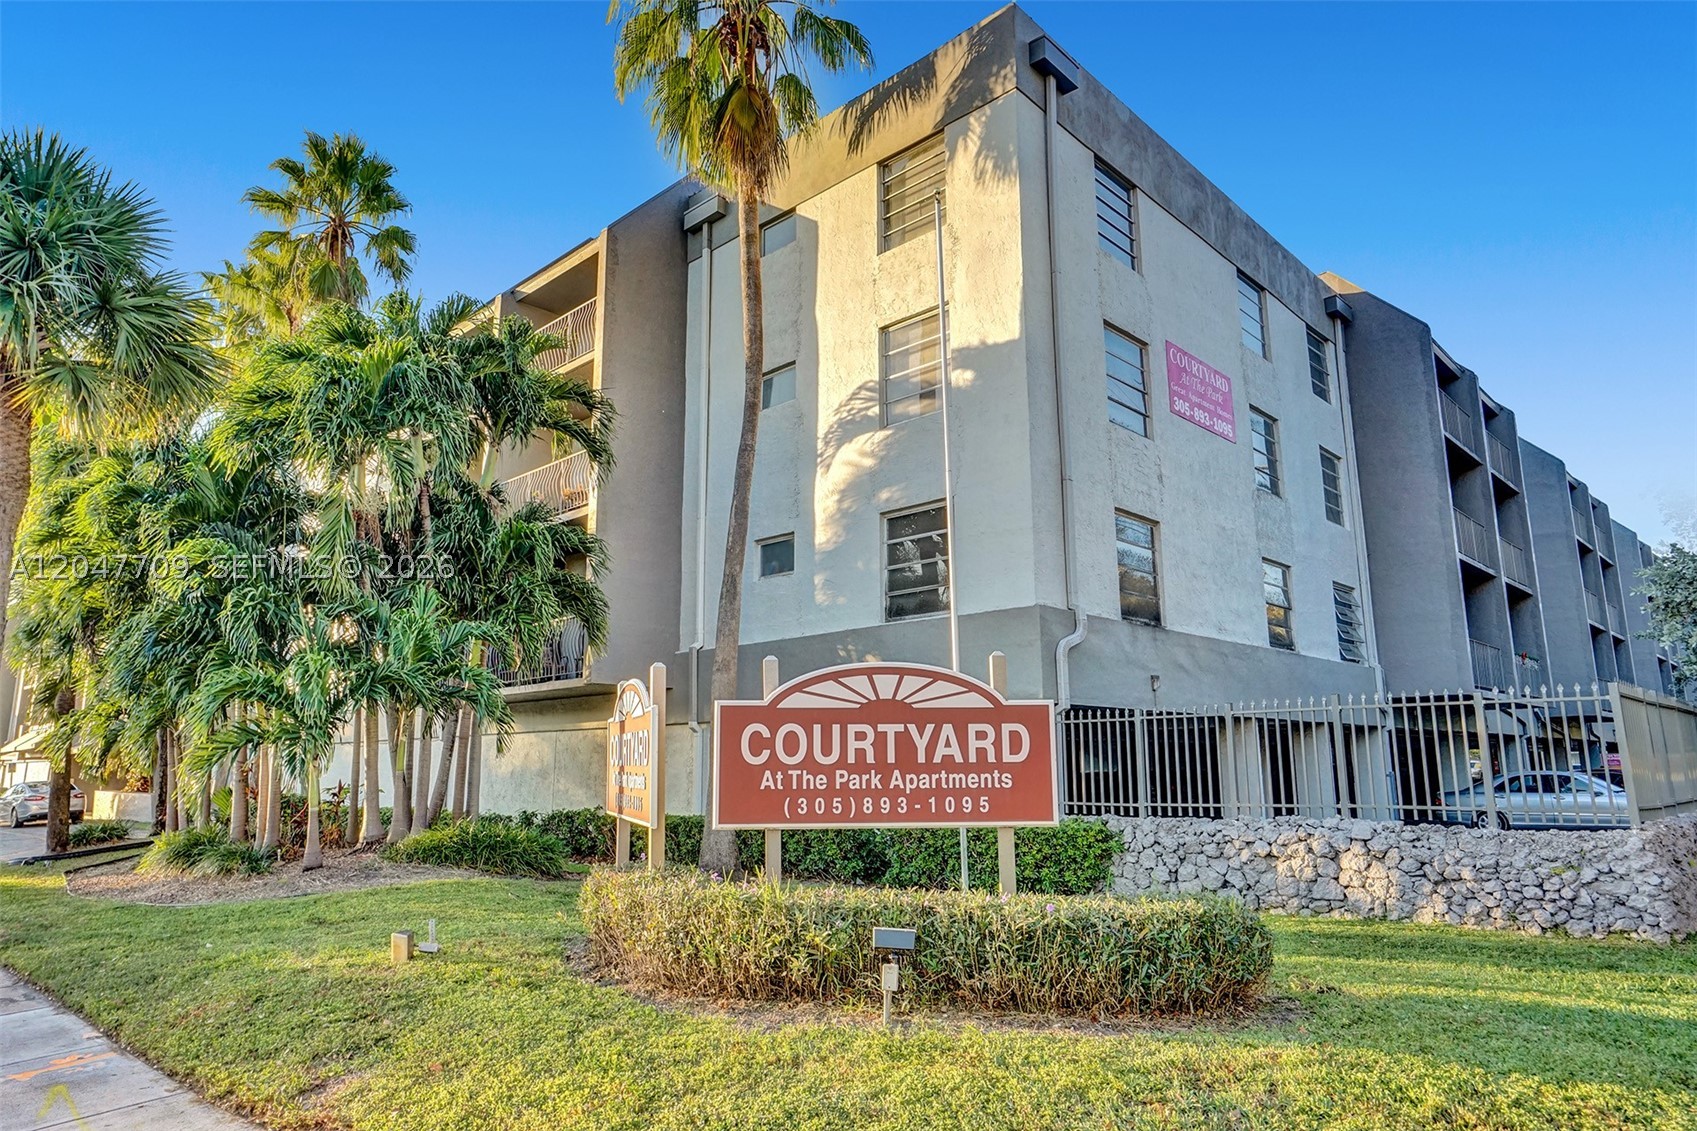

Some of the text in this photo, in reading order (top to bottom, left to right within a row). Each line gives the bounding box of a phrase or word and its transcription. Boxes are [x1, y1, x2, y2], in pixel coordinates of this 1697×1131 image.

[1170, 348, 1229, 393] COURTYARD
[740, 722, 1031, 766] COURTYARD
[760, 769, 1013, 794] At The Park Apartments
[784, 796, 990, 818] (305)893-1095
